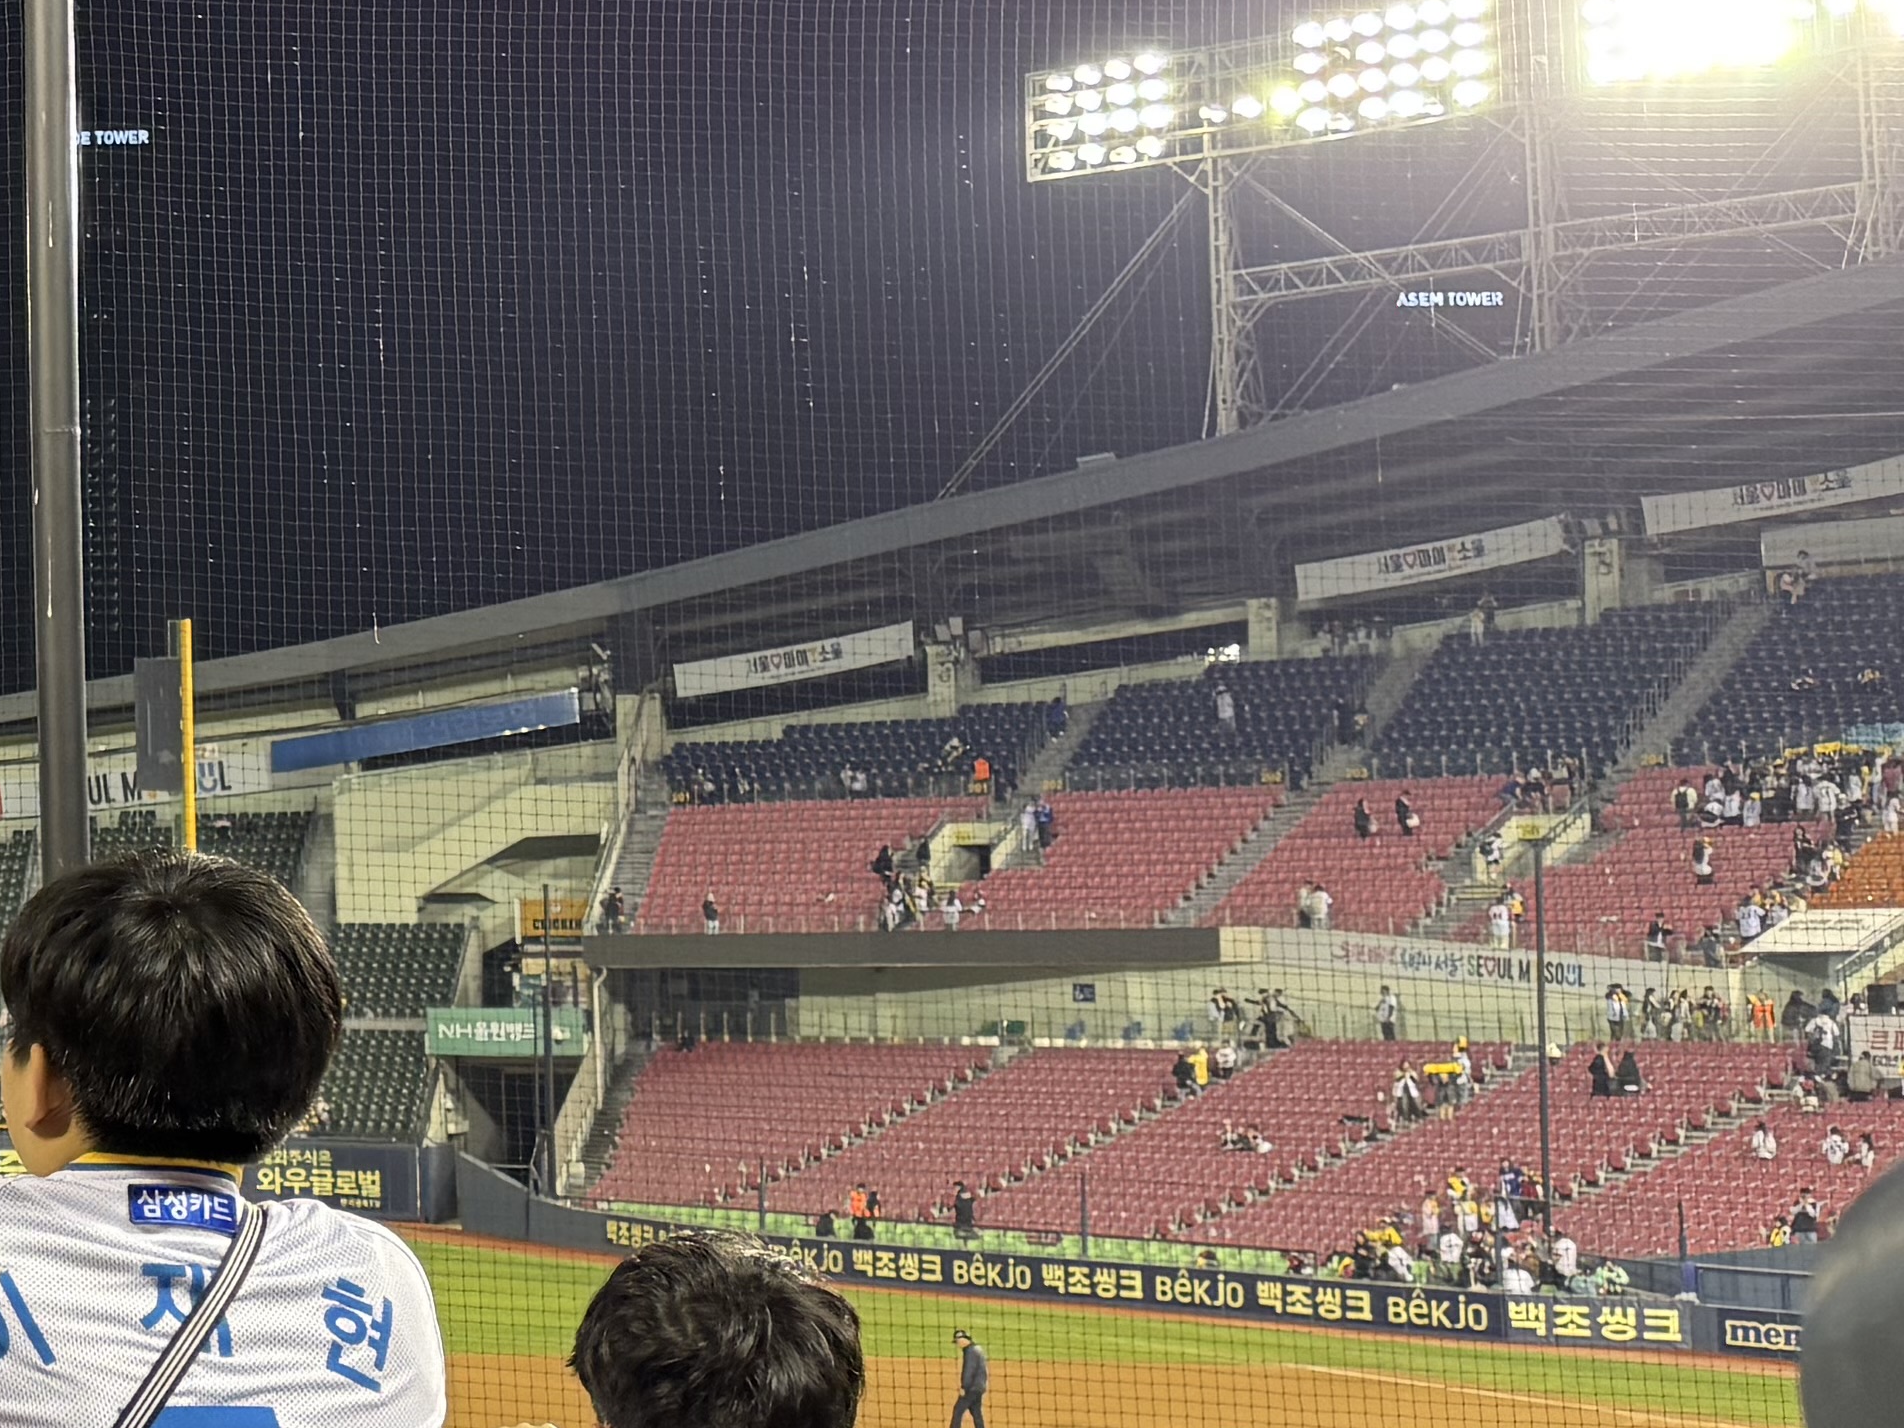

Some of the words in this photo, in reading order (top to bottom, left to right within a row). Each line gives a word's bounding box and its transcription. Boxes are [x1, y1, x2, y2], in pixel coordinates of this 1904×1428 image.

[95, 130, 149, 145] TOWER
[1397, 291, 1444, 306] ASEM
[1448, 292, 1503, 306] TOWER
[1544, 960, 1586, 988] SOUL
[256, 1166, 382, 1199] 와우글로벌
[137, 1188, 234, 1223] 삼성카드
[852, 1247, 942, 1283] 백조씽크
[1041, 1263, 1144, 1300] 백조씽크
[1257, 1280, 1373, 1322] 백조씽크
[1508, 1300, 1683, 1343] 백조씽크
